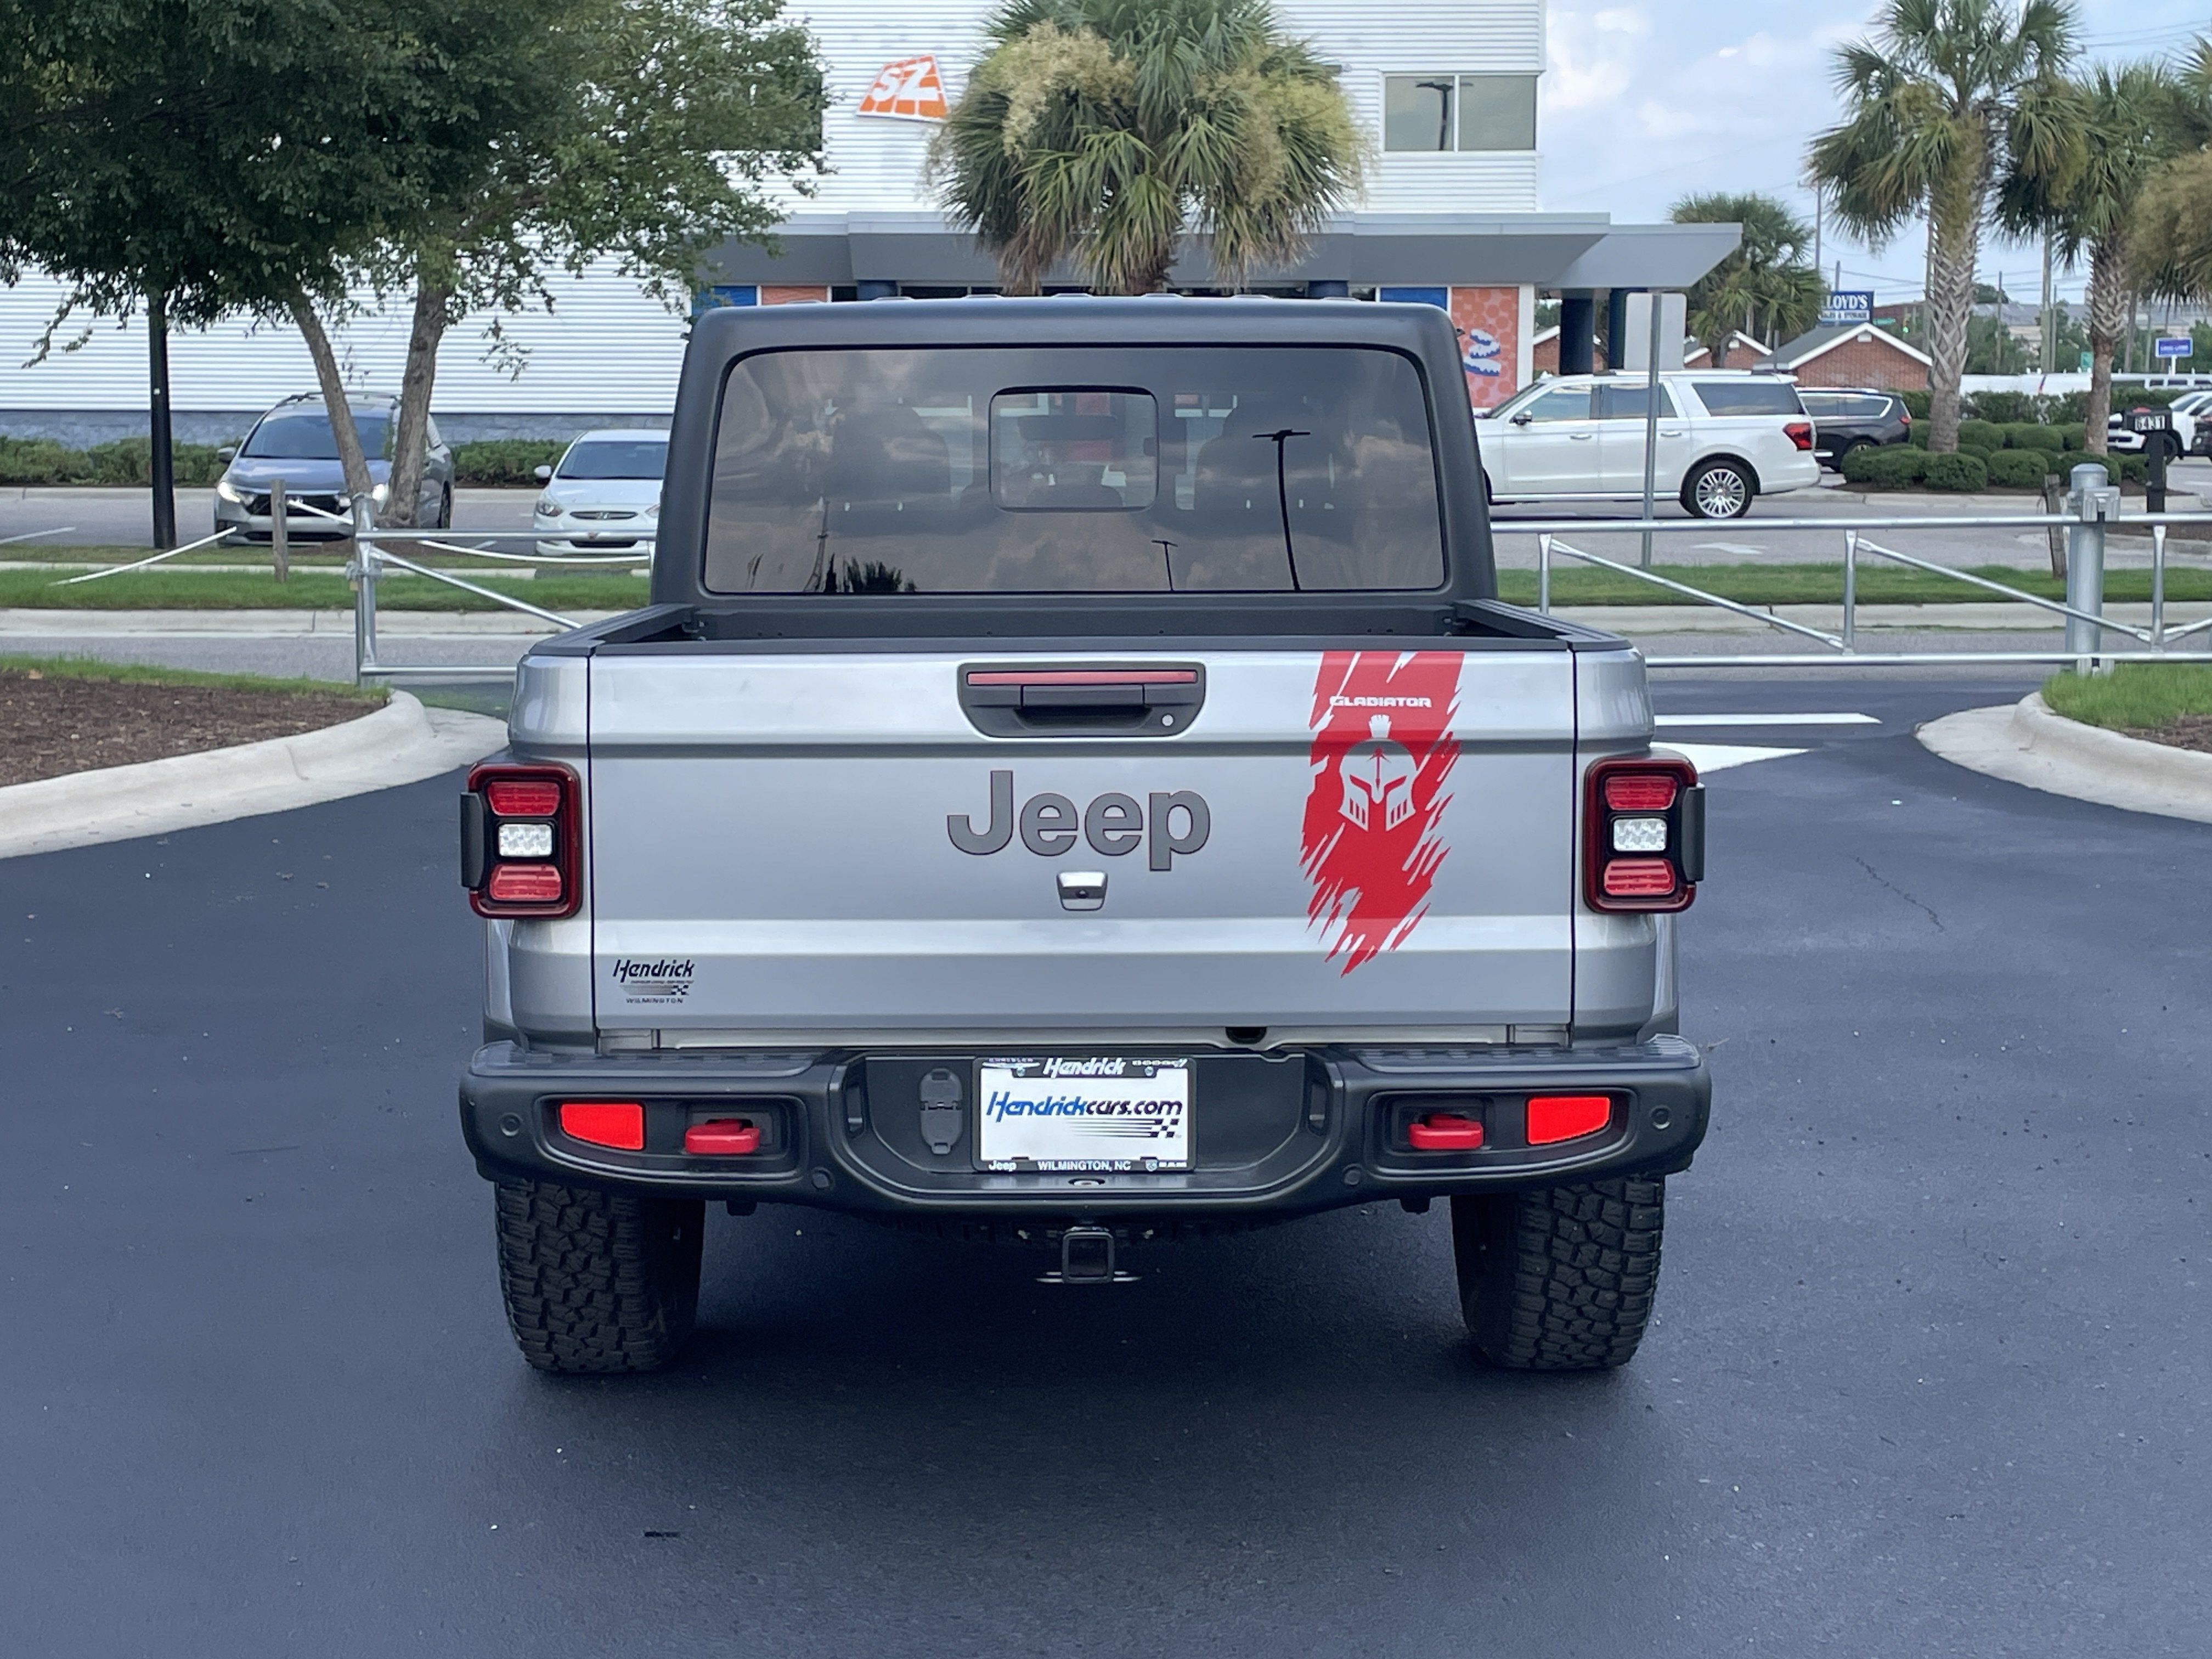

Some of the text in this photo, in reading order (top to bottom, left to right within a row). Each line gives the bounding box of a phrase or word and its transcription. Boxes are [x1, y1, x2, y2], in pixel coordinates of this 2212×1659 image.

[2135, 416, 2164, 431] 6431
[1329, 696, 1432, 708] GLADIATOR
[947, 770, 1210, 871] Jeep
[612, 959, 695, 983] Hendrick
[1043, 1057, 1126, 1078] Hendrick
[986, 1091, 1183, 1123] Hendrickcars.com
[989, 1160, 1017, 1172] Jeep
[1037, 1160, 1132, 1172] WILMINGTON, NC
